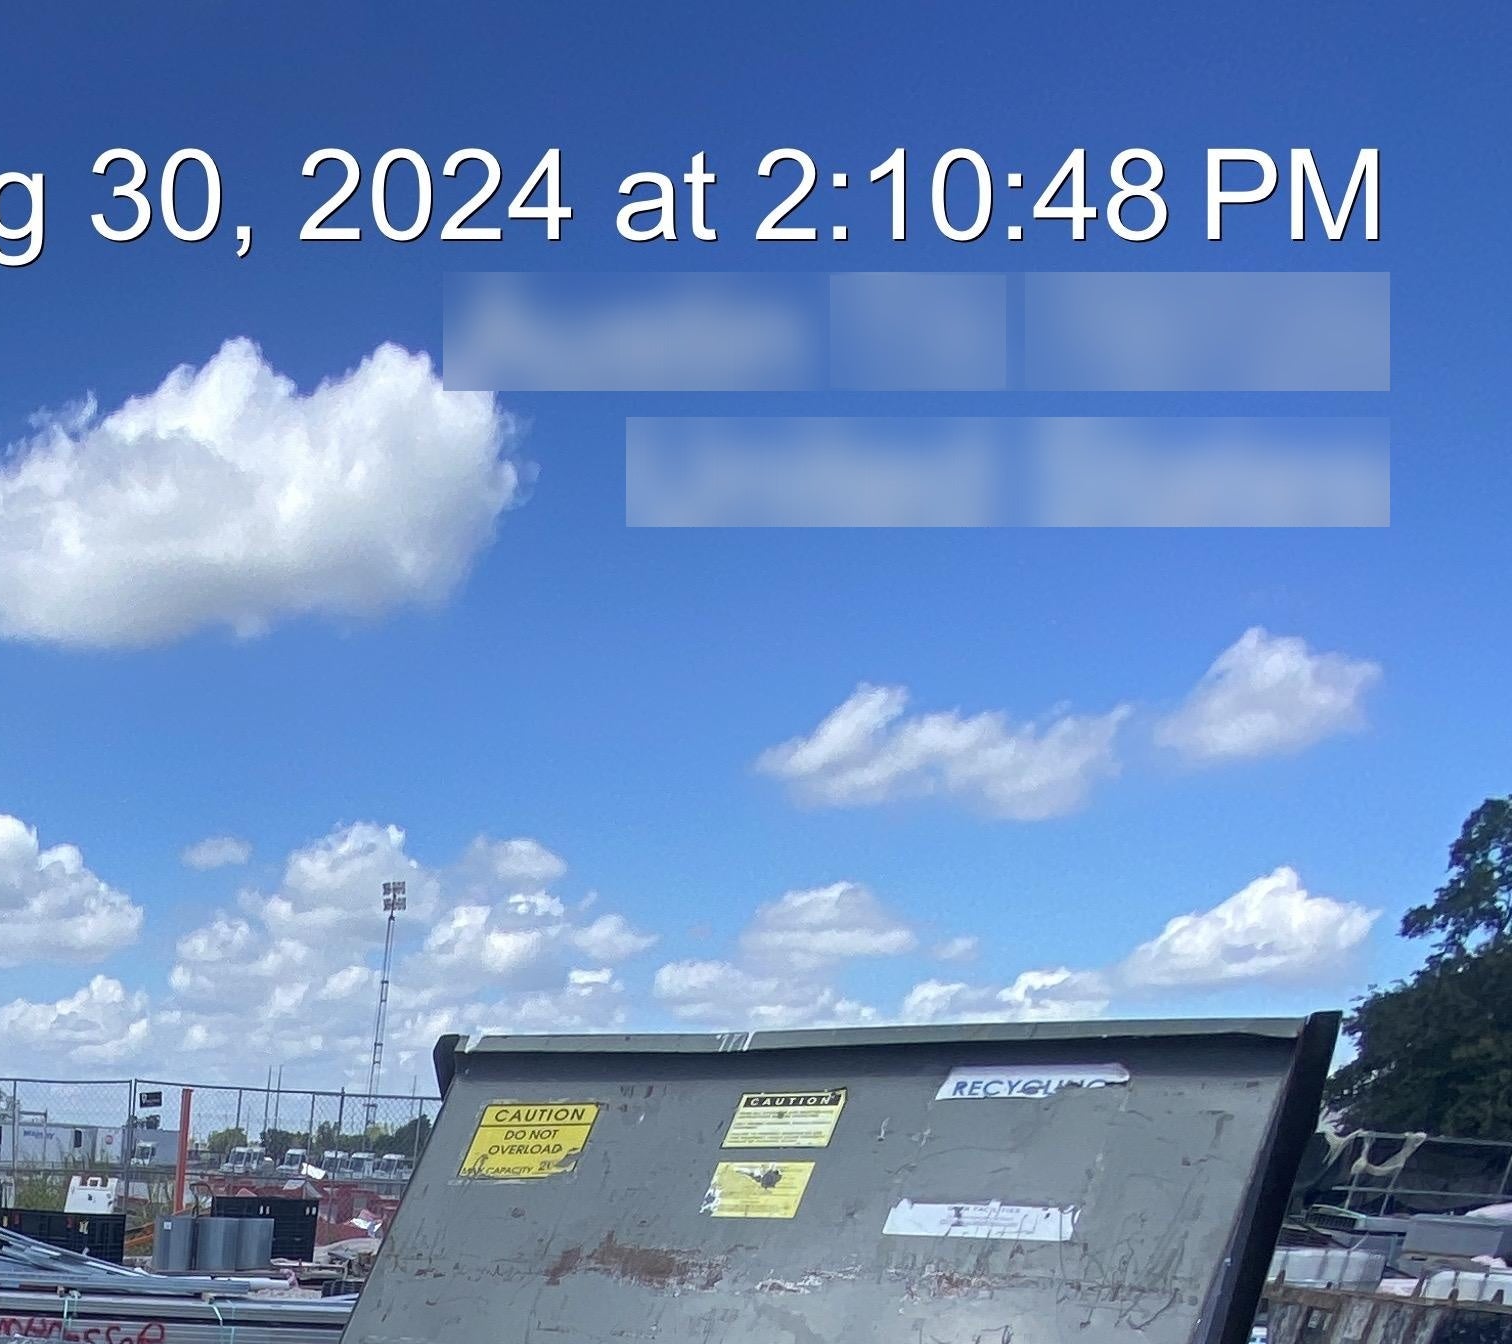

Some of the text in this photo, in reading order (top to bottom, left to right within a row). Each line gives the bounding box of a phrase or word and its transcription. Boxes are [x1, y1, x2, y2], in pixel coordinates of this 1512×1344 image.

[750, 1095, 830, 1106] CAUTION
[494, 1108, 585, 1122] CAUTION
[504, 1129, 559, 1140] DO NOT
[488, 1143, 562, 1155] OVERLOAD
[486, 1166, 533, 1174] CAPACITY
